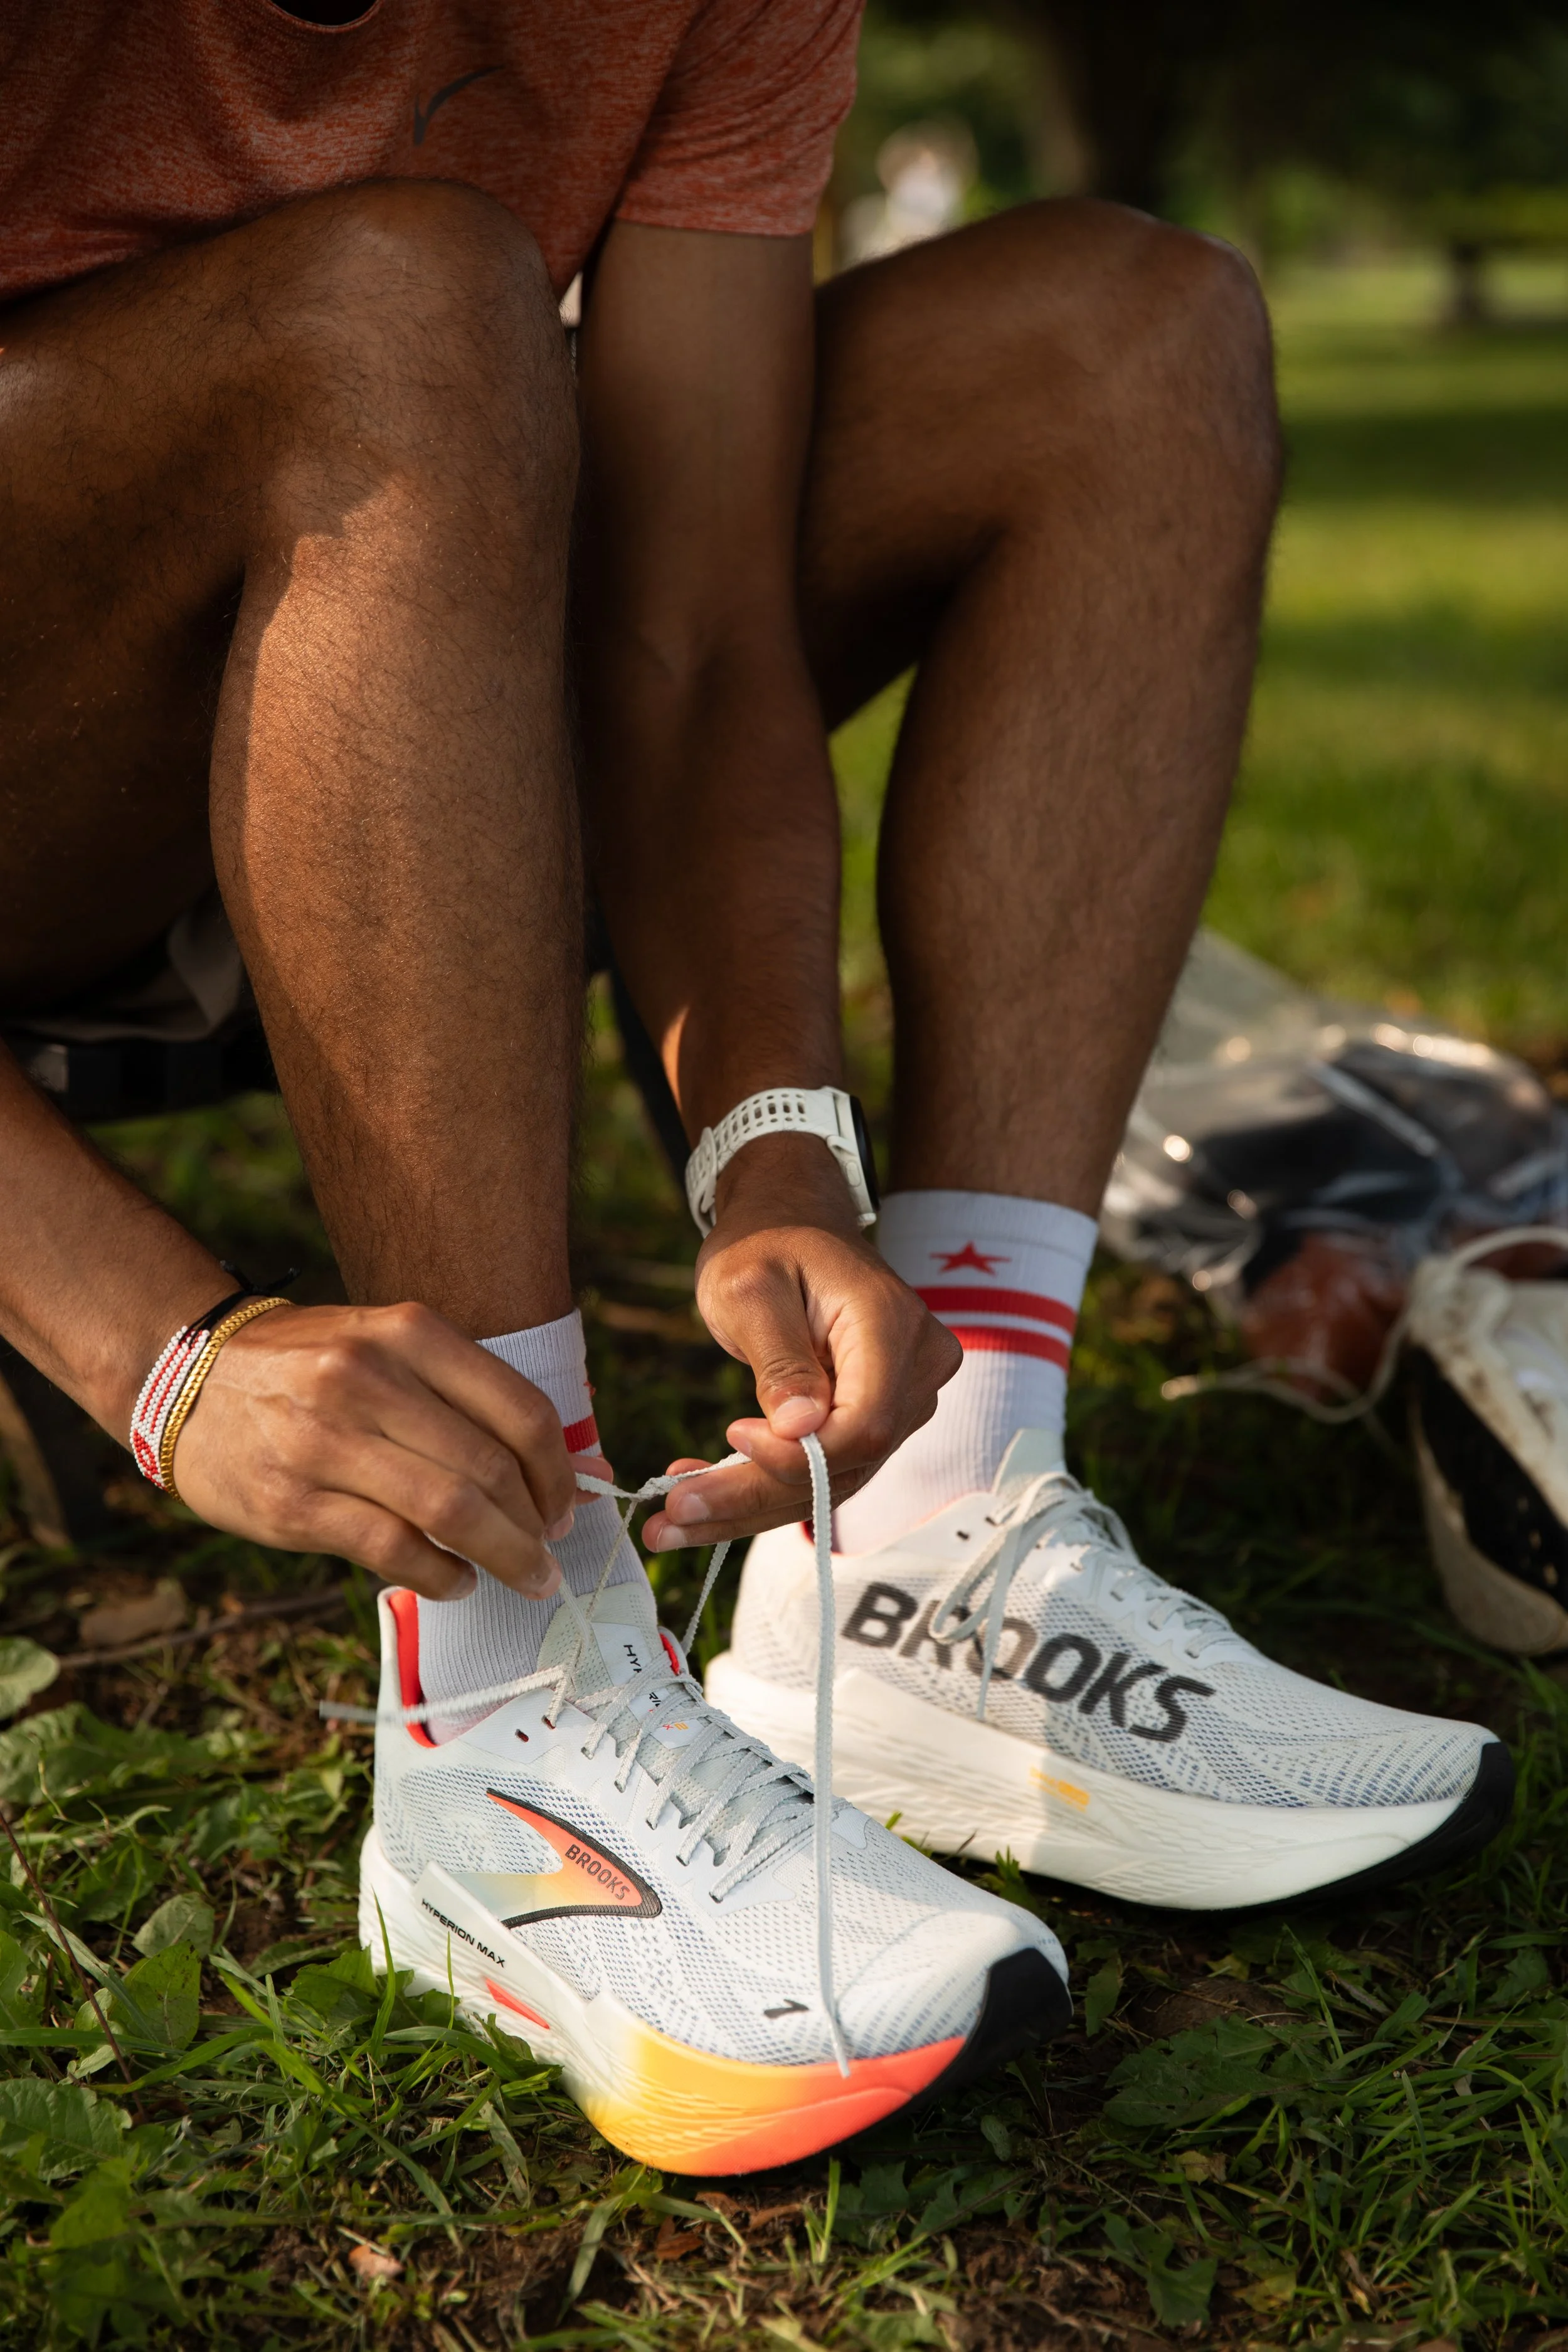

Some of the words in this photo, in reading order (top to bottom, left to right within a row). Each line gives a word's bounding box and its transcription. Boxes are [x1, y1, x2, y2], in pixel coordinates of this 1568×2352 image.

[841, 1581, 1217, 1742] BROOKS
[564, 1843, 630, 1900] BROOKS
[421, 1898, 475, 1946] HYPERION
[477, 1942, 506, 1968] MAX
